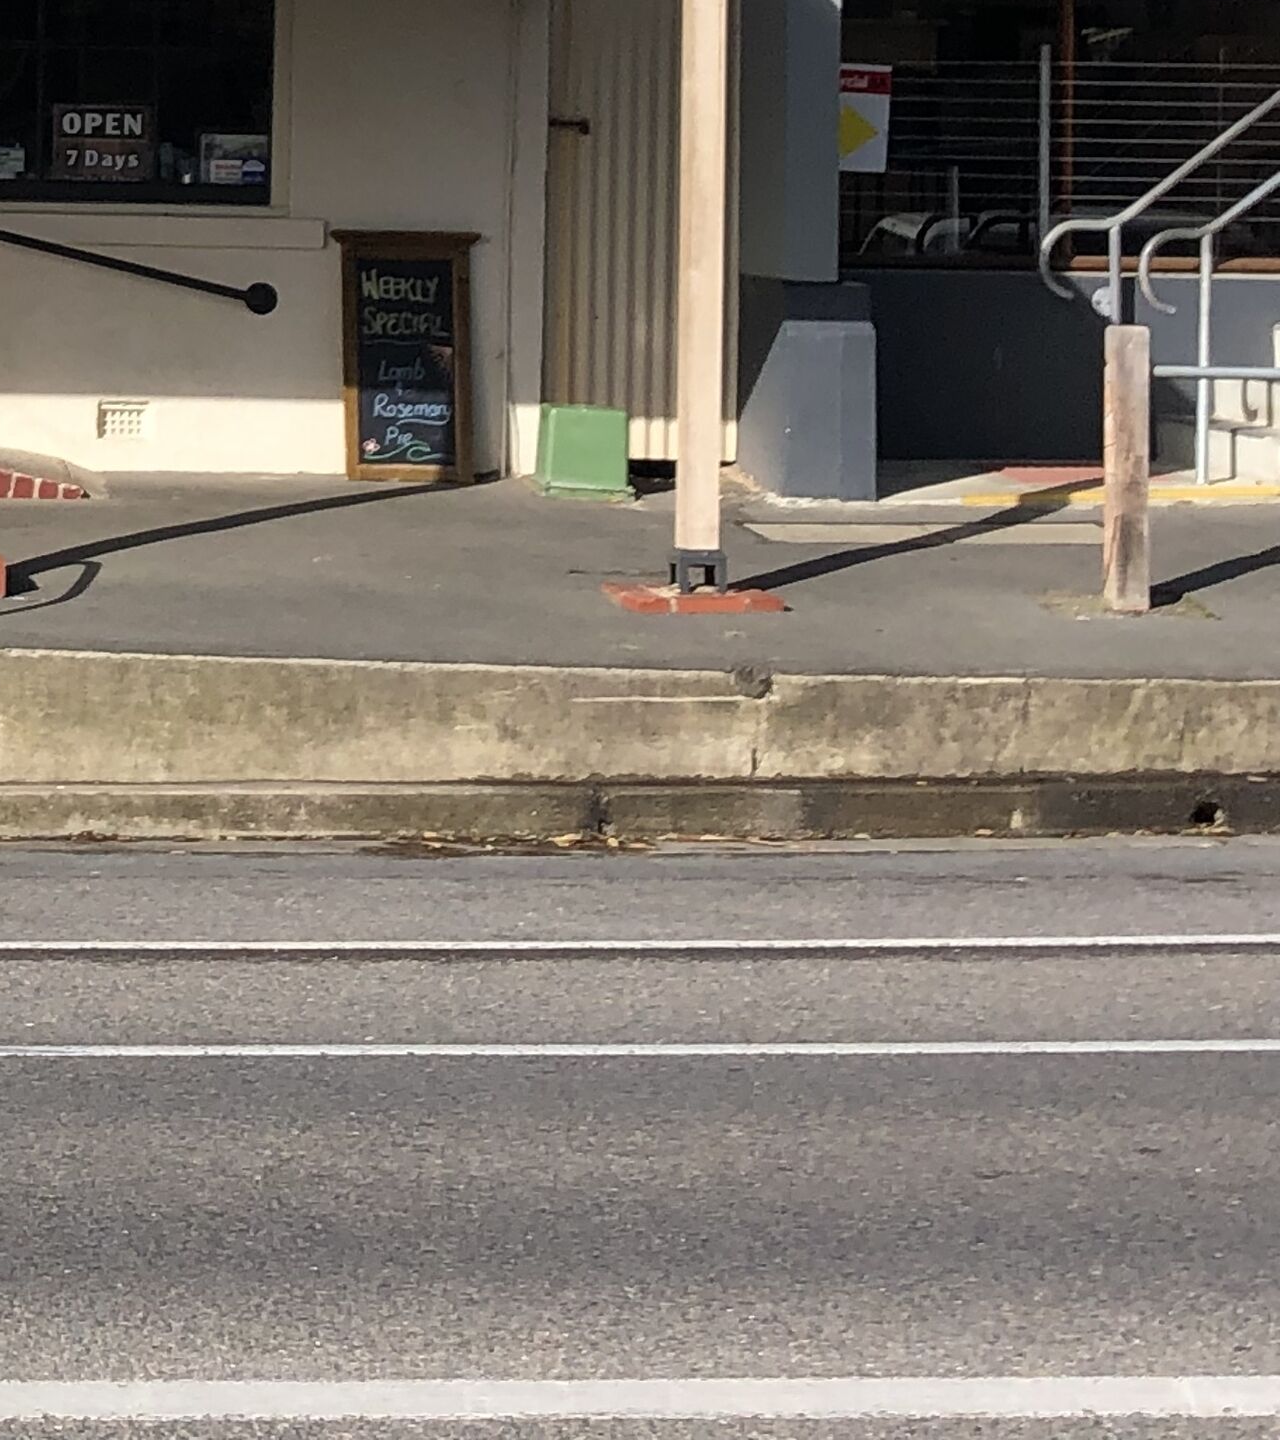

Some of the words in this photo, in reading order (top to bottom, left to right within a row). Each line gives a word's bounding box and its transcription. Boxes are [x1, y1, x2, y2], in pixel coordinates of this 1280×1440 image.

[62, 111, 143, 136] OPEN
[65, 149, 77, 167] 7
[84, 150, 140, 171] Days
[361, 268, 440, 303] WEEKLY
[363, 306, 450, 336] SPECIAL
